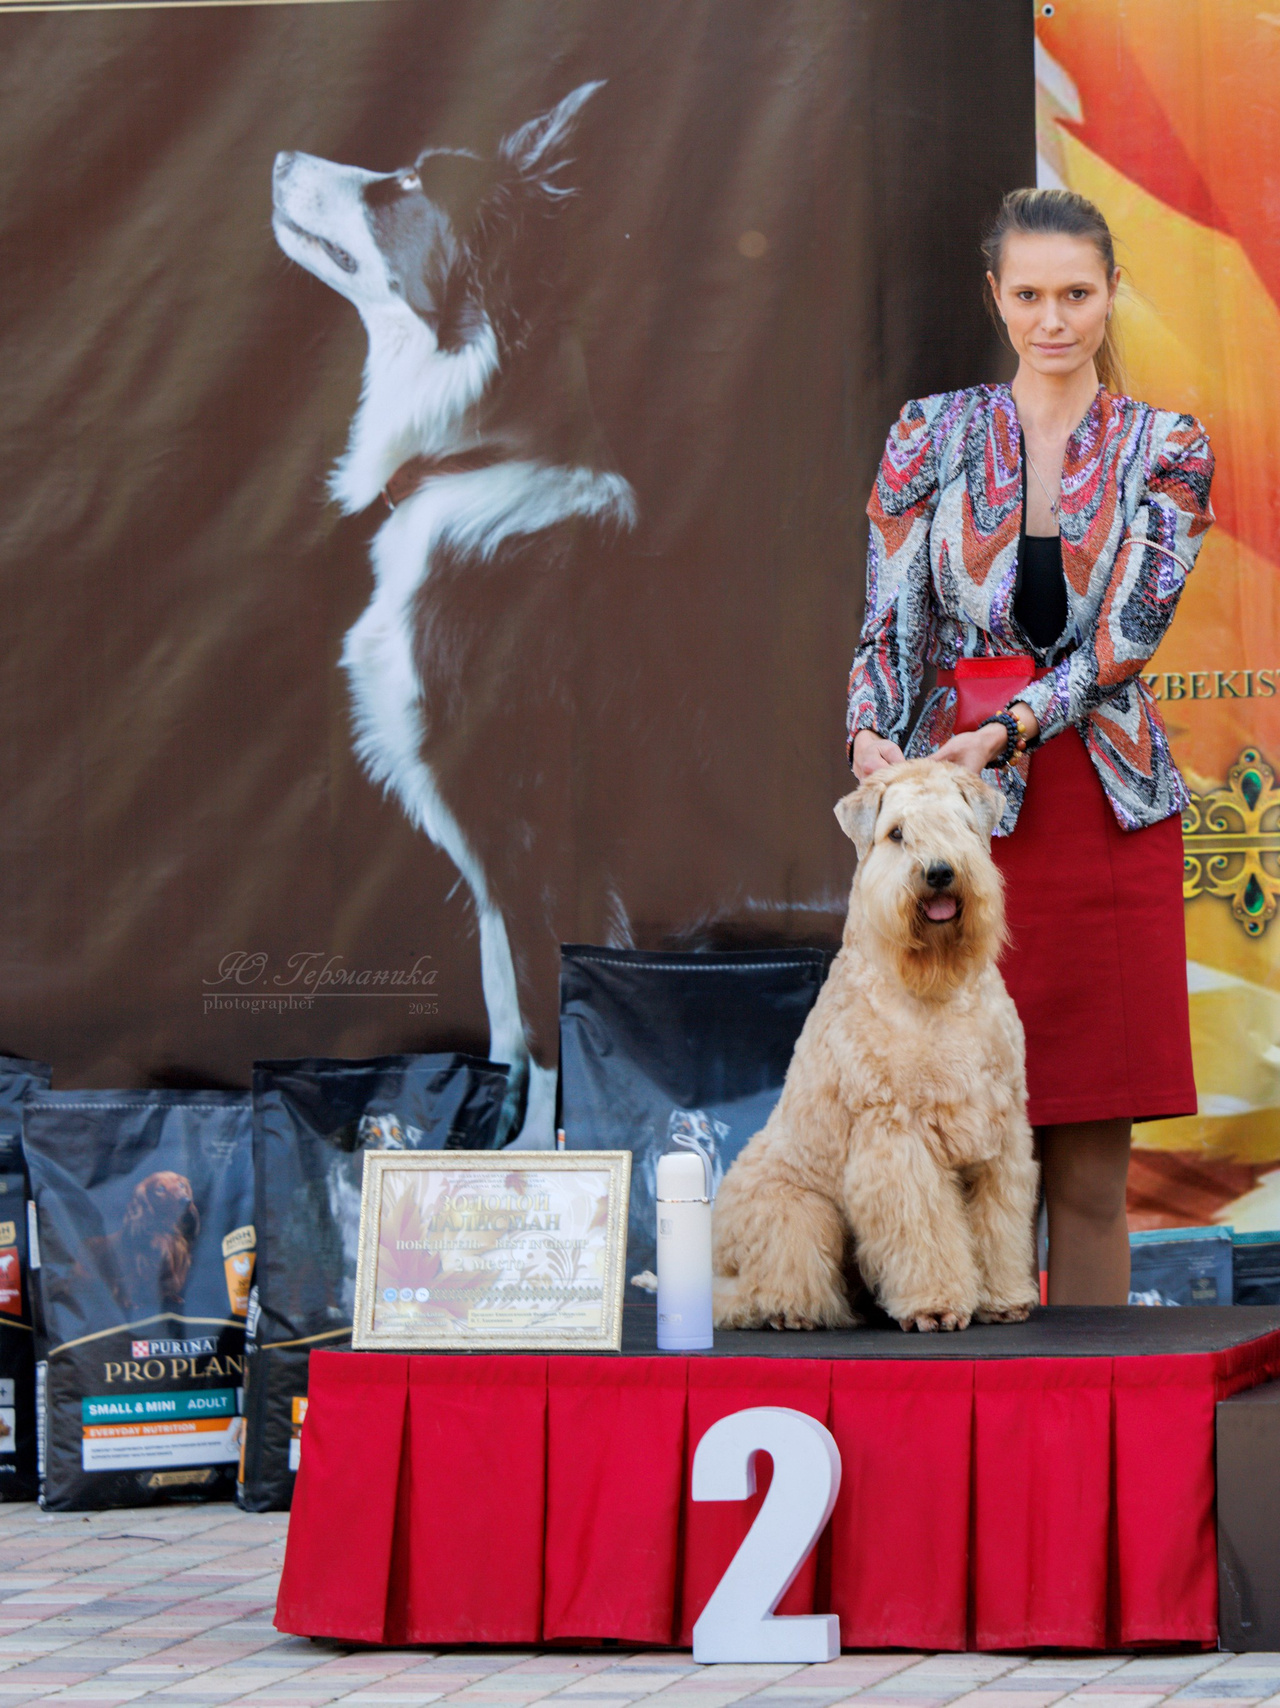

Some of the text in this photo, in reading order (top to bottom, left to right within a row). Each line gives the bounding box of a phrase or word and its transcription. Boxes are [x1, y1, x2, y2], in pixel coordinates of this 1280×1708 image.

[441, 1191, 551, 1212] ЗОЛОТОЙ
[454, 1258, 464, 1272] 2
[149, 1340, 214, 1355] PURINA
[104, 1354, 247, 1383] PRO PLAN
[88, 1397, 228, 1416] SMALL & MINI ADULT
[89, 1423, 197, 1437] EVERYDAY NUTRITION
[692, 1406, 842, 1663] 2
